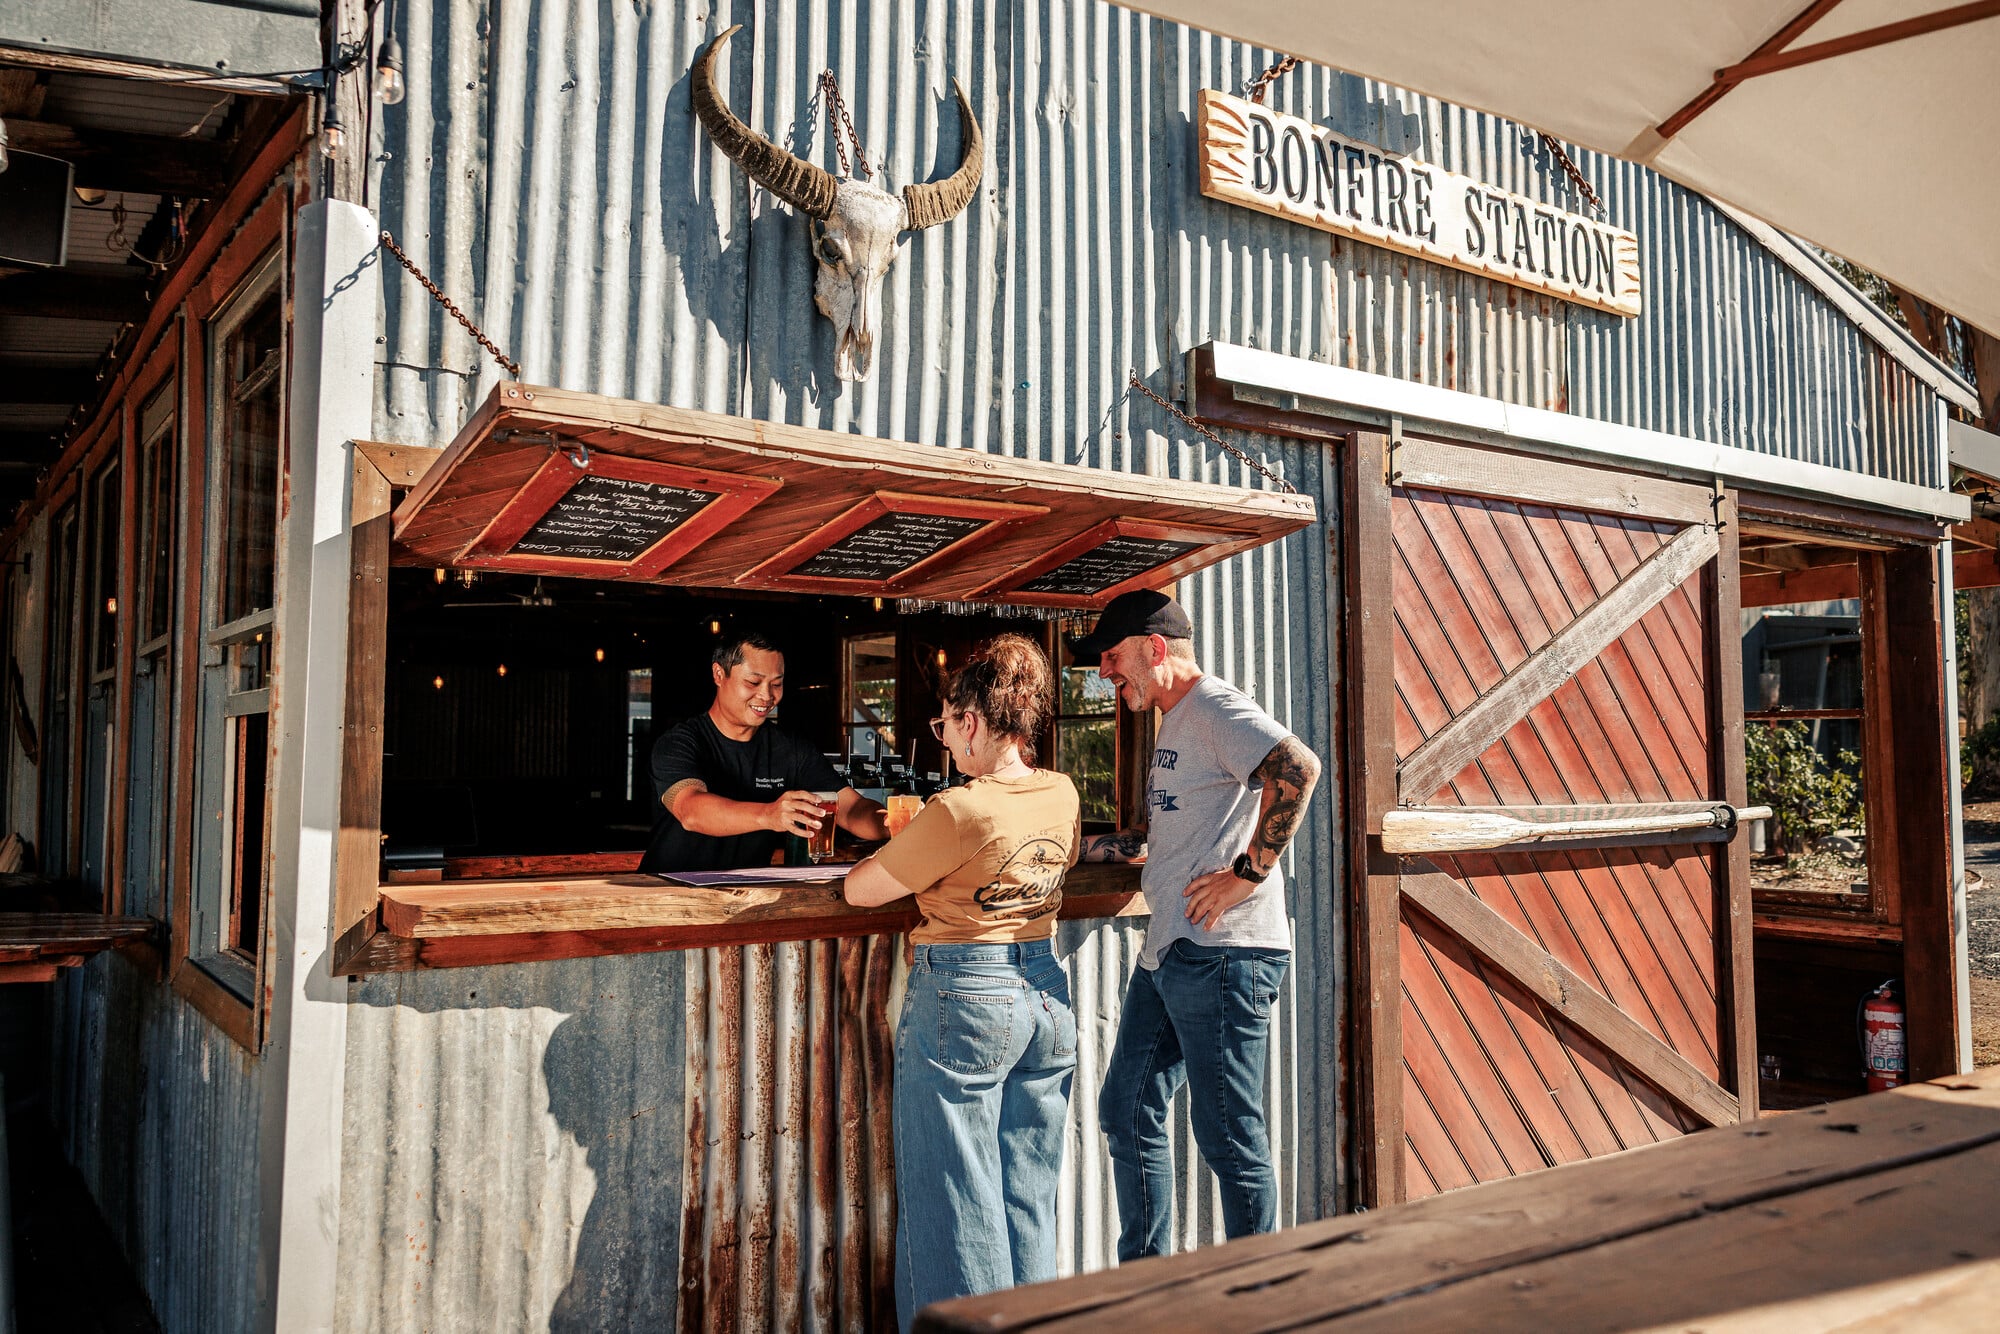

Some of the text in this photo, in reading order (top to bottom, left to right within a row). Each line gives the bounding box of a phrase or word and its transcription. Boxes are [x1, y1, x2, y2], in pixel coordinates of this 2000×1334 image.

[1249, 113, 1616, 298] BONFIRE STATION
[627, 481, 652, 491] fresh
[658, 487, 684, 496] with
[687, 489, 707, 502] Try
[557, 503, 585, 511] with
[573, 494, 687, 512] subtle Fuji apple
[589, 503, 609, 515] dry
[628, 511, 678, 523] Medium
[536, 527, 648, 545] Straw appearance
[623, 526, 657, 535] with
[900, 529, 929, 539] earthy
[849, 534, 902, 545] balanced
[930, 533, 954, 541] with
[518, 542, 561, 553] CIDER
[566, 547, 602, 556] WORLD
[847, 541, 933, 554] Smooth caramel
[880, 559, 908, 567] Copper
[836, 569, 880, 577] AMBER
[997, 850, 1011, 864] THE
